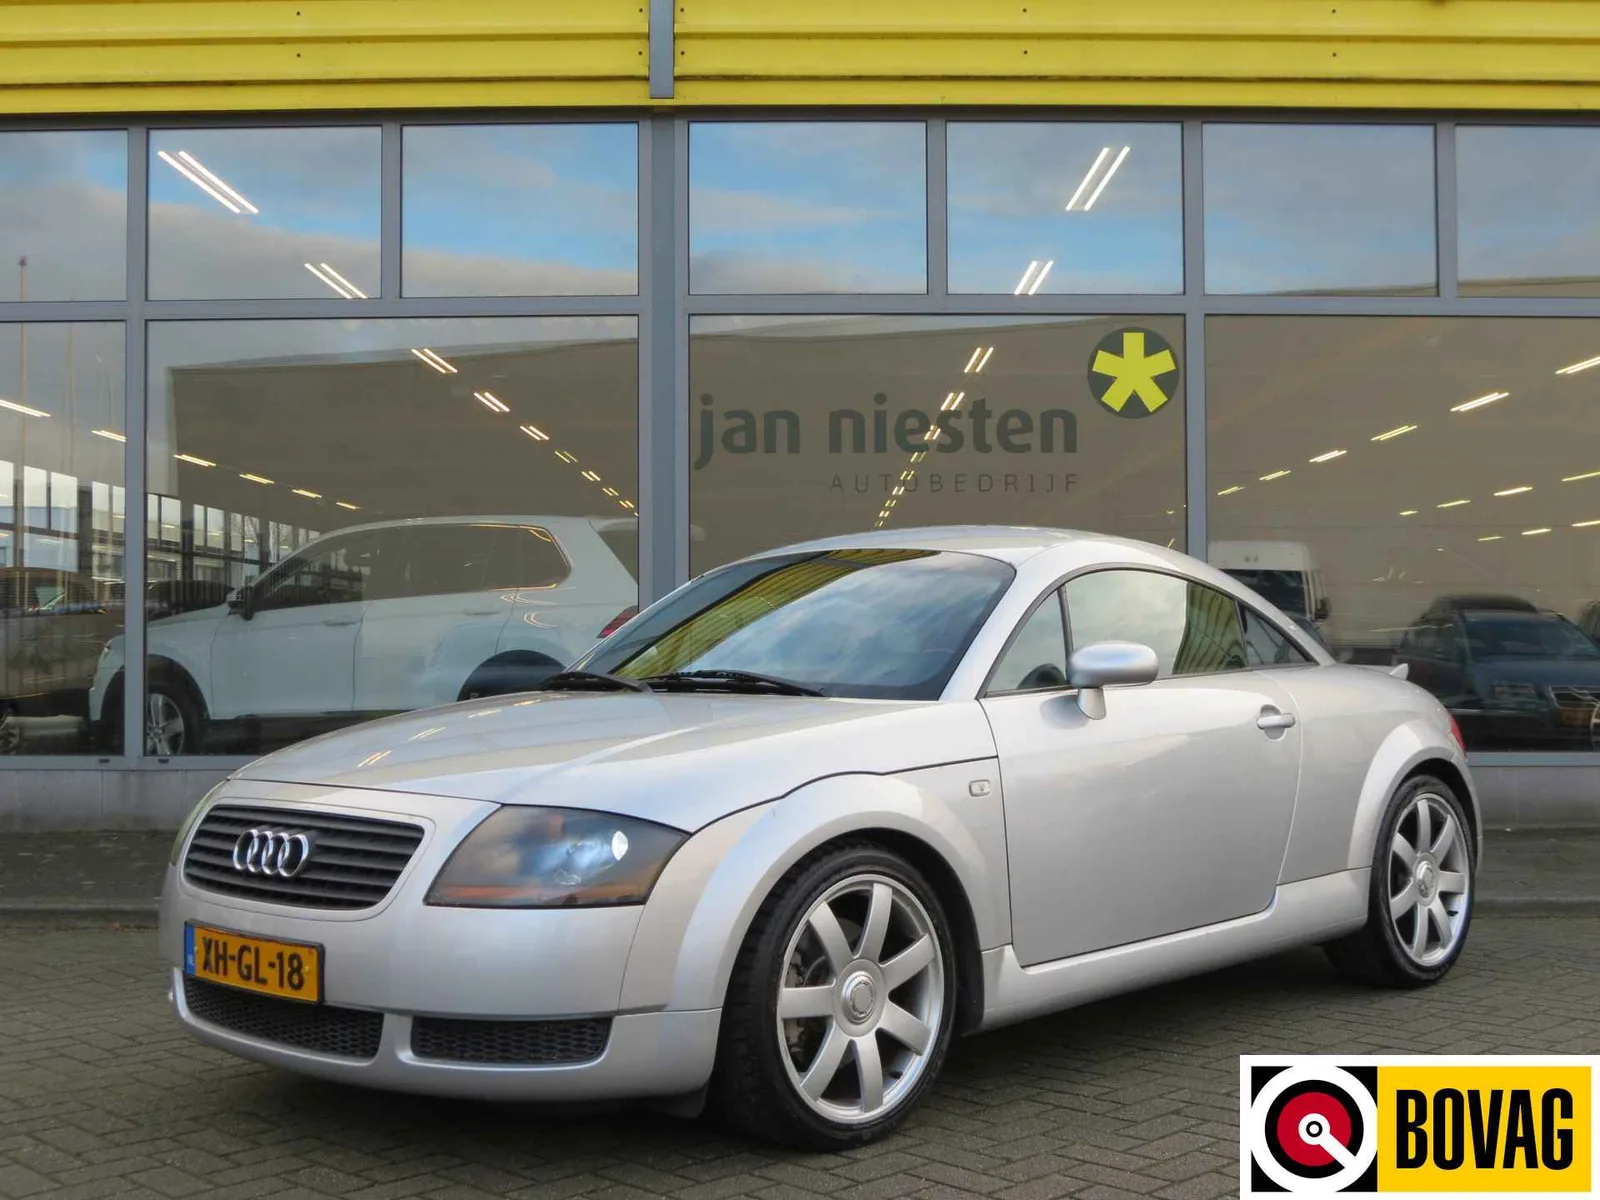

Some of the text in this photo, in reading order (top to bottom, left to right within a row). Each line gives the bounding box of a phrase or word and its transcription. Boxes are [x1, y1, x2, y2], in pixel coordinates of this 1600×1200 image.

[694, 392, 1078, 470] jan niesten
[829, 473, 1078, 493] AUTOBEDRIJF
[201, 936, 304, 991] XH-GL-18
